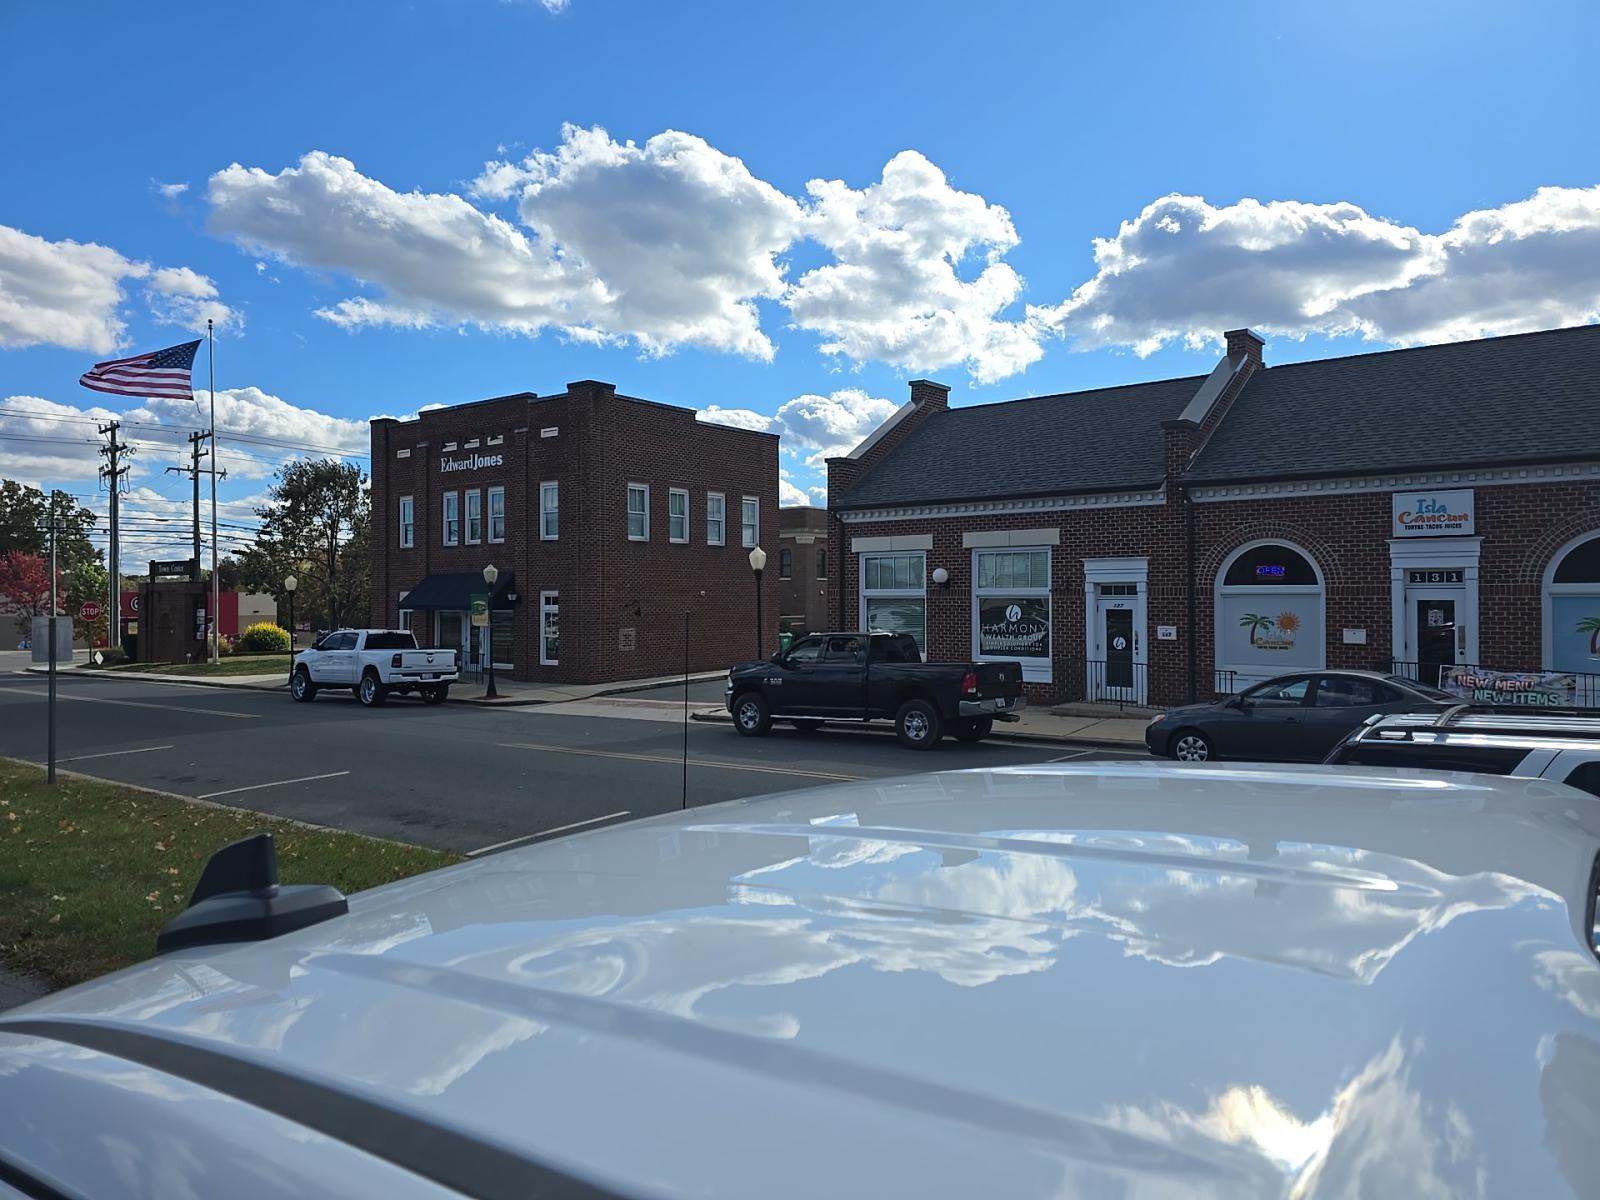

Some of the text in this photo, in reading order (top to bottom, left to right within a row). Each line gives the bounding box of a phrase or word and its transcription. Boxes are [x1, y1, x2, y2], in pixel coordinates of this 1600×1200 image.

[1416, 498, 1447, 514] Isla
[1398, 511, 1470, 524] Cancun
[1415, 573, 1458, 582] 131
[81, 608, 100, 616] STOP
[982, 624, 1047, 633] HARMONY
[985, 633, 1015, 641] WEALTH
[1457, 675, 1535, 691] NEW MENU
[1474, 689, 1559, 706] NEW ITEMS
